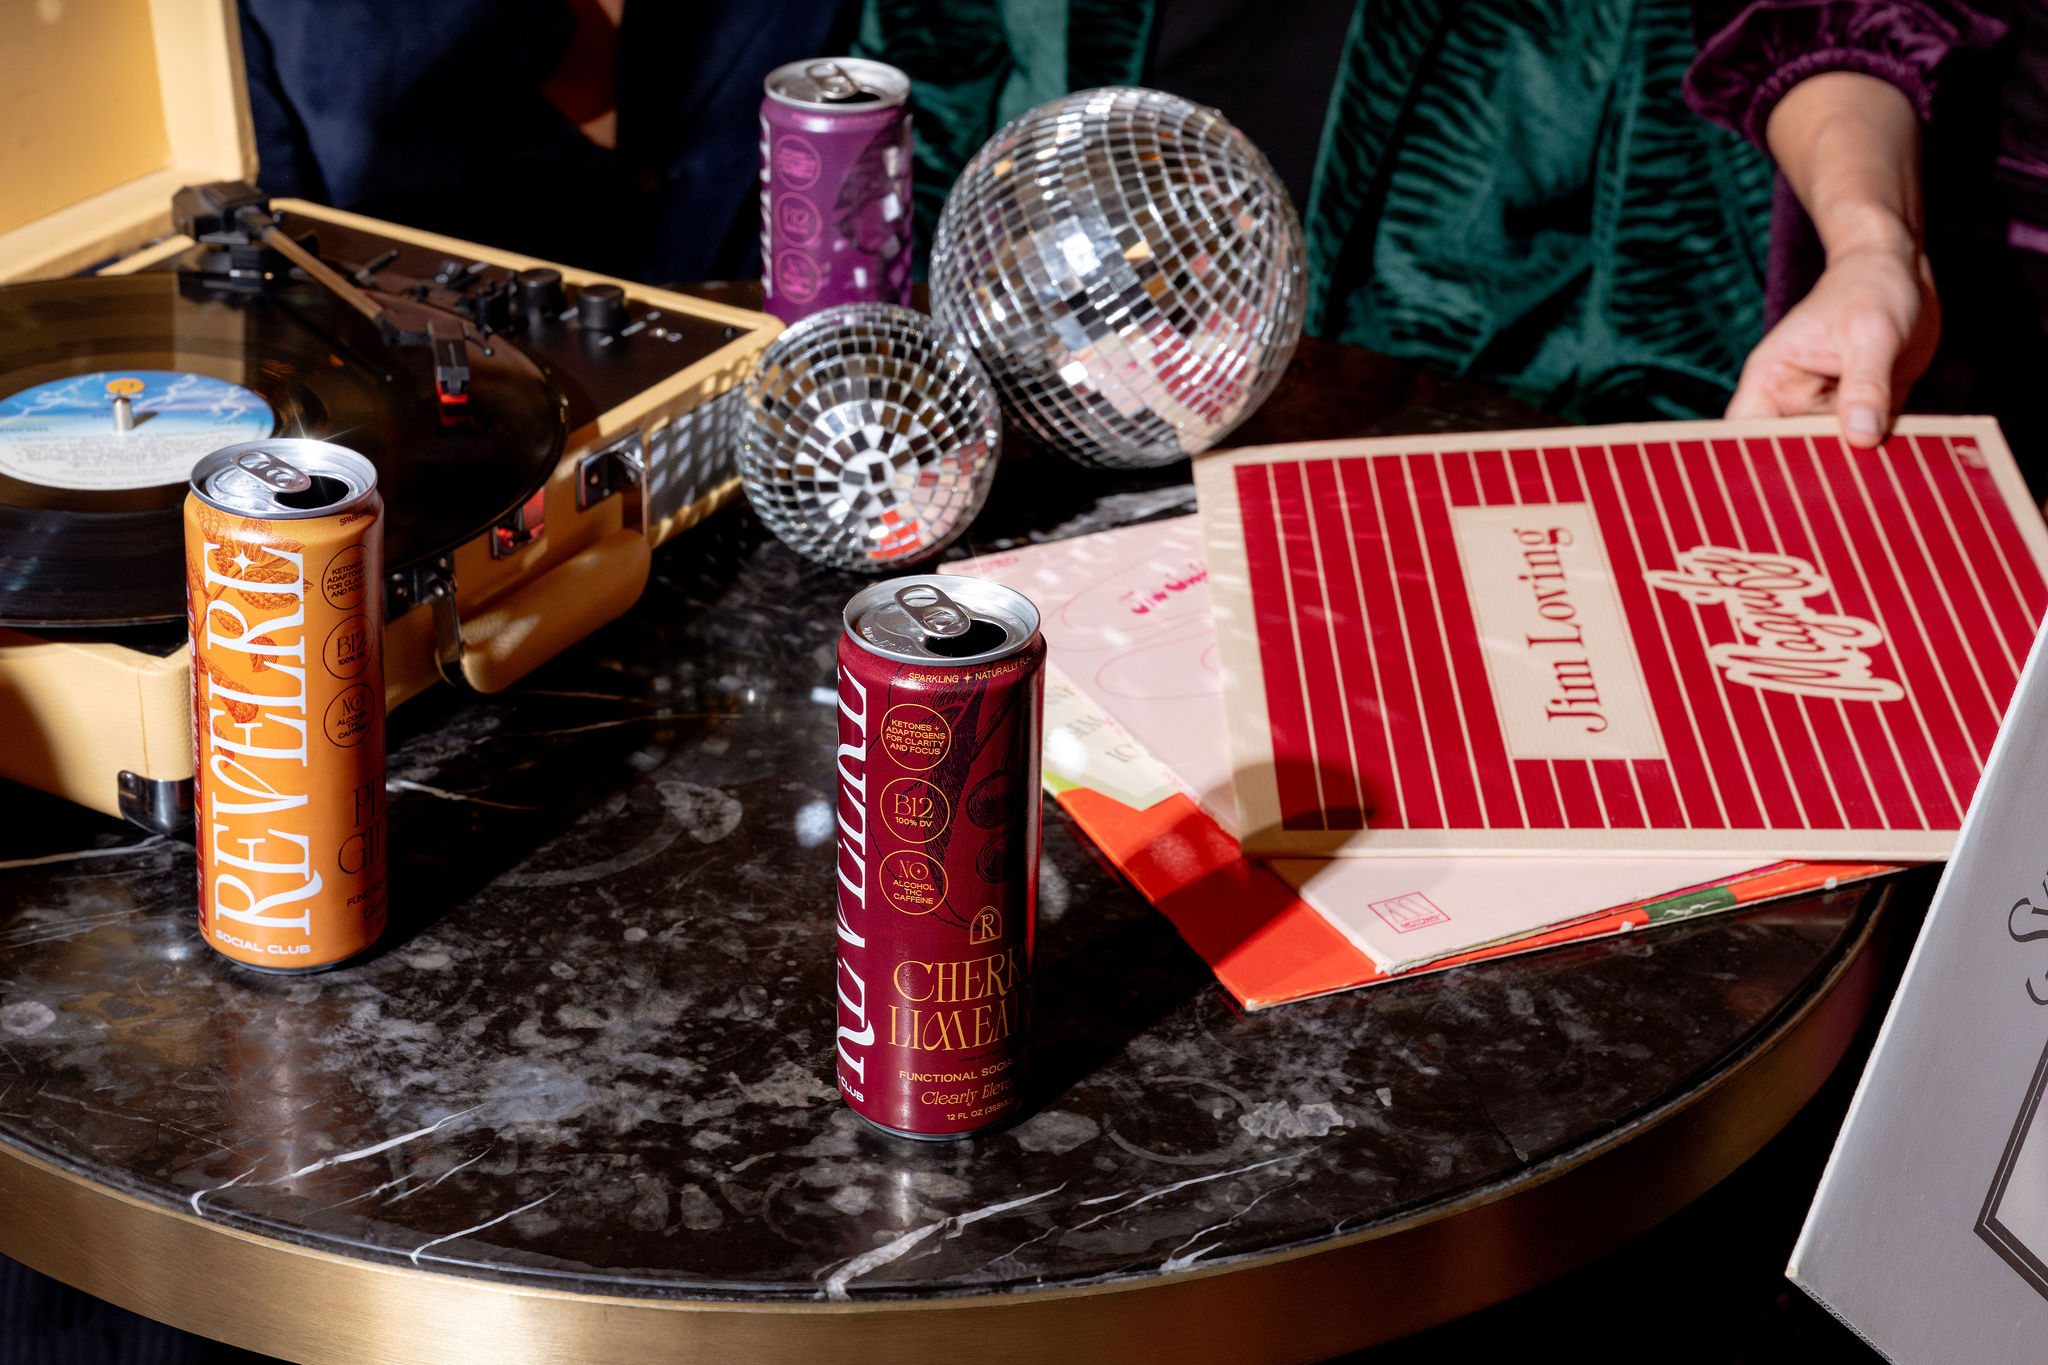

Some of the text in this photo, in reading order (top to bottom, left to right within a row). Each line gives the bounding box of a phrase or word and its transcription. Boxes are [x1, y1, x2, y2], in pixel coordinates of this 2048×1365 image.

[326, 582, 343, 592] FOR
[330, 588, 348, 599] AND
[1512, 526, 1608, 733] Jim Loving
[336, 629, 366, 658] B12
[908, 672, 959, 684] SPARKLING
[975, 661, 1018, 681] NATURALLY
[342, 693, 365, 716] NO
[886, 725, 946, 740] ADAPTOGENS
[891, 718, 932, 732] KETONES
[886, 733, 944, 748] FOR CLARITY
[890, 742, 941, 755] AND FOCUS
[894, 792, 935, 819] B12
[894, 816, 933, 828] 100% DV
[899, 859, 929, 881] NO
[892, 879, 935, 891] ALCOHOL
[904, 887, 923, 898] THC
[893, 892, 934, 905] CAFFEINE
[215, 928, 311, 955] SOCIAL CLUB
[899, 1070, 978, 1083] FUNCTIONAL
[840, 1075, 864, 1102] CLUB
[921, 1088, 978, 1107] Clearly
[946, 1112, 956, 1121] 12
[957, 1111, 969, 1120] FL
[971, 1108, 983, 1118] OZ
